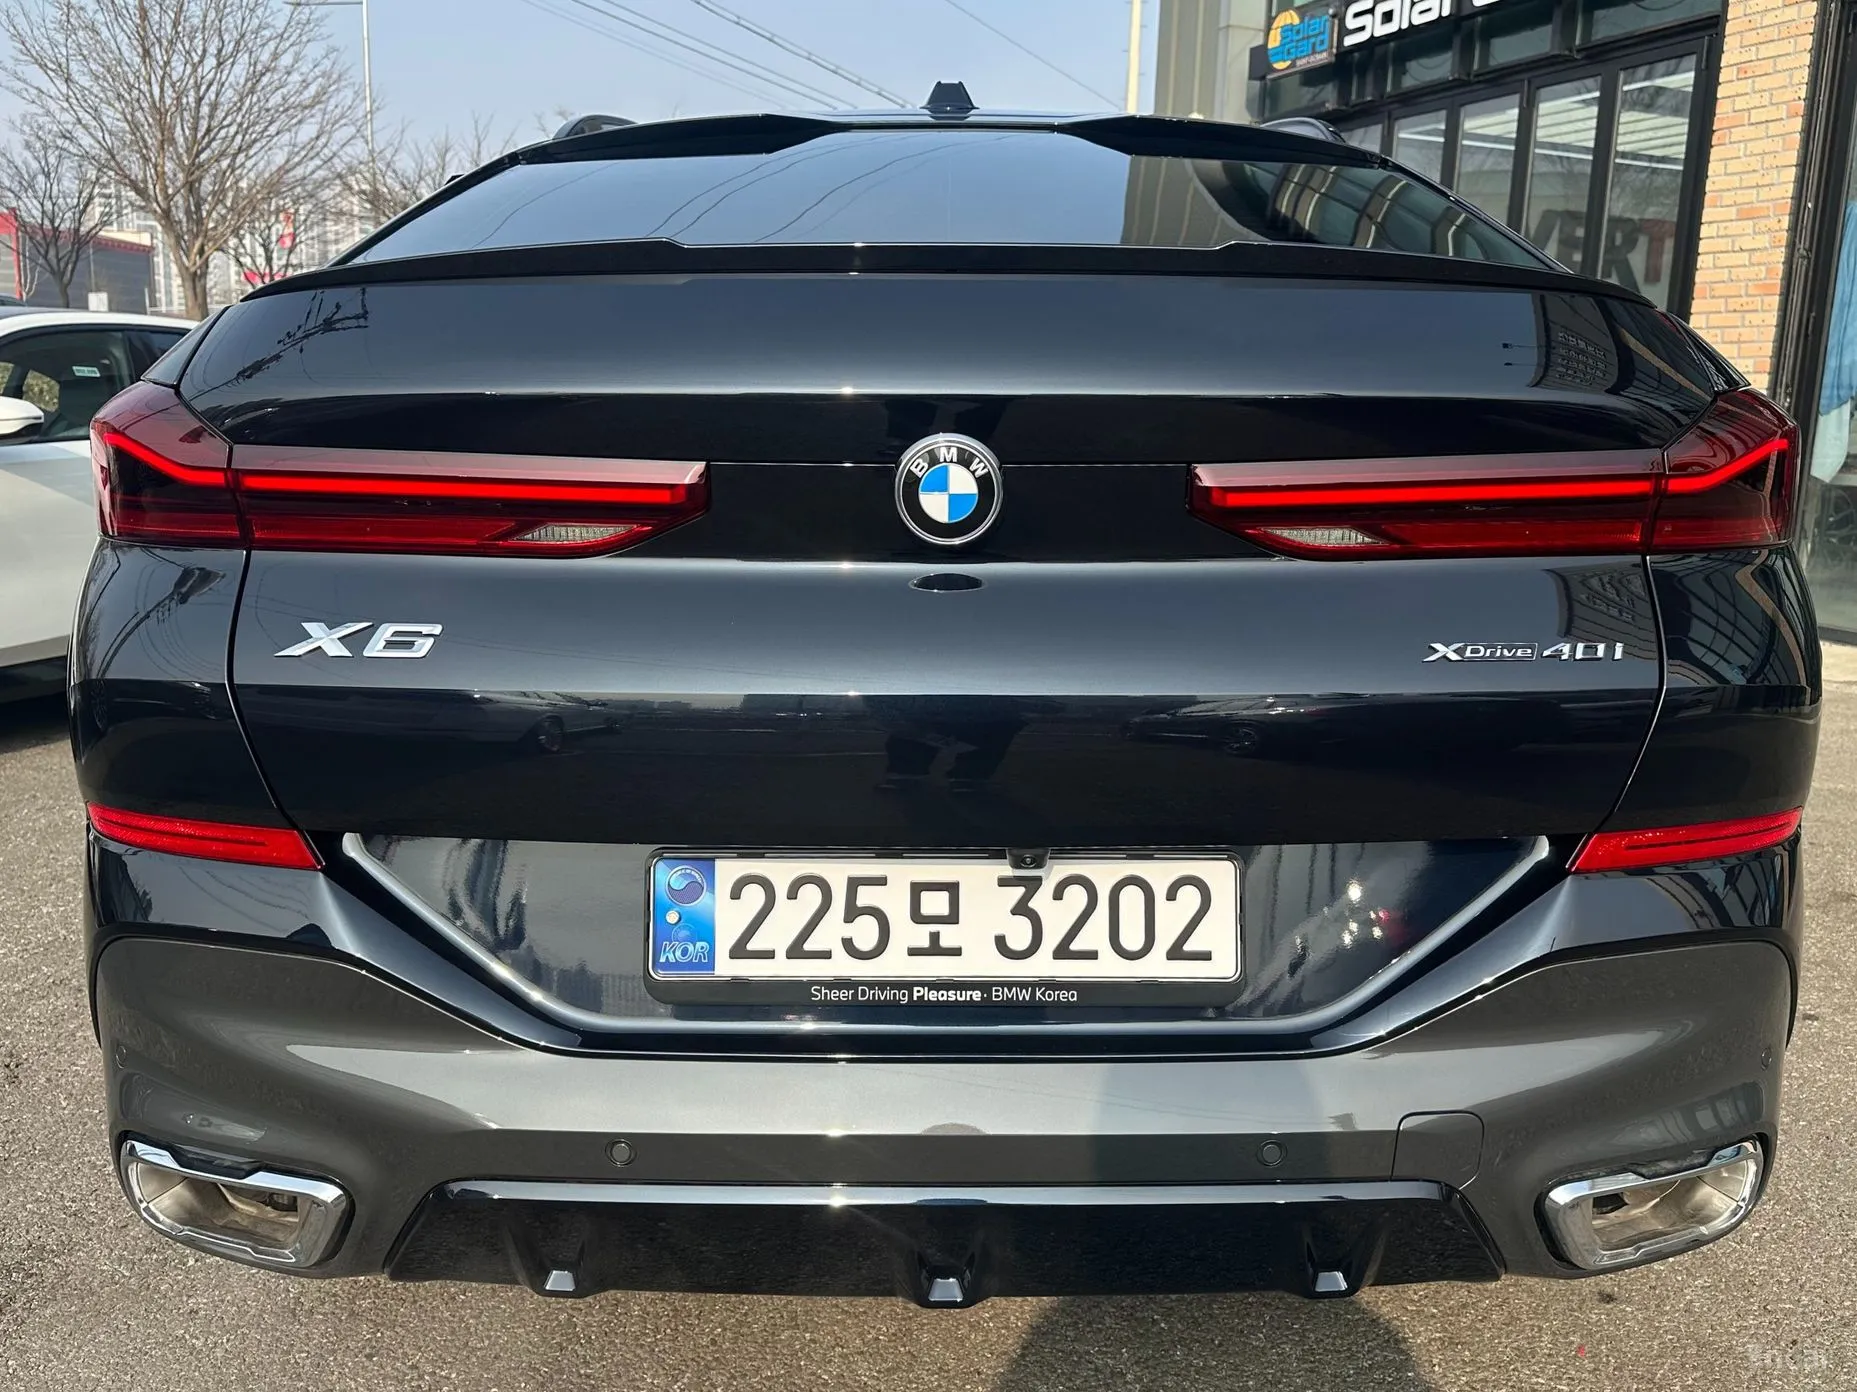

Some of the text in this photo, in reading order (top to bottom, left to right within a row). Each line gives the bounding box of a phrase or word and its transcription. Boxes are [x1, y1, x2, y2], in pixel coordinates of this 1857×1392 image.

[1281, 15, 1329, 45] Solar
[1283, 31, 1329, 61] Gard
[909, 446, 989, 479] BMW
[274, 621, 443, 659] X6
[728, 872, 1213, 961] 225모 3202
[660, 941, 710, 962] KOR
[811, 985, 1077, 1003] Sheer Driving Pleasure BMW Korea
